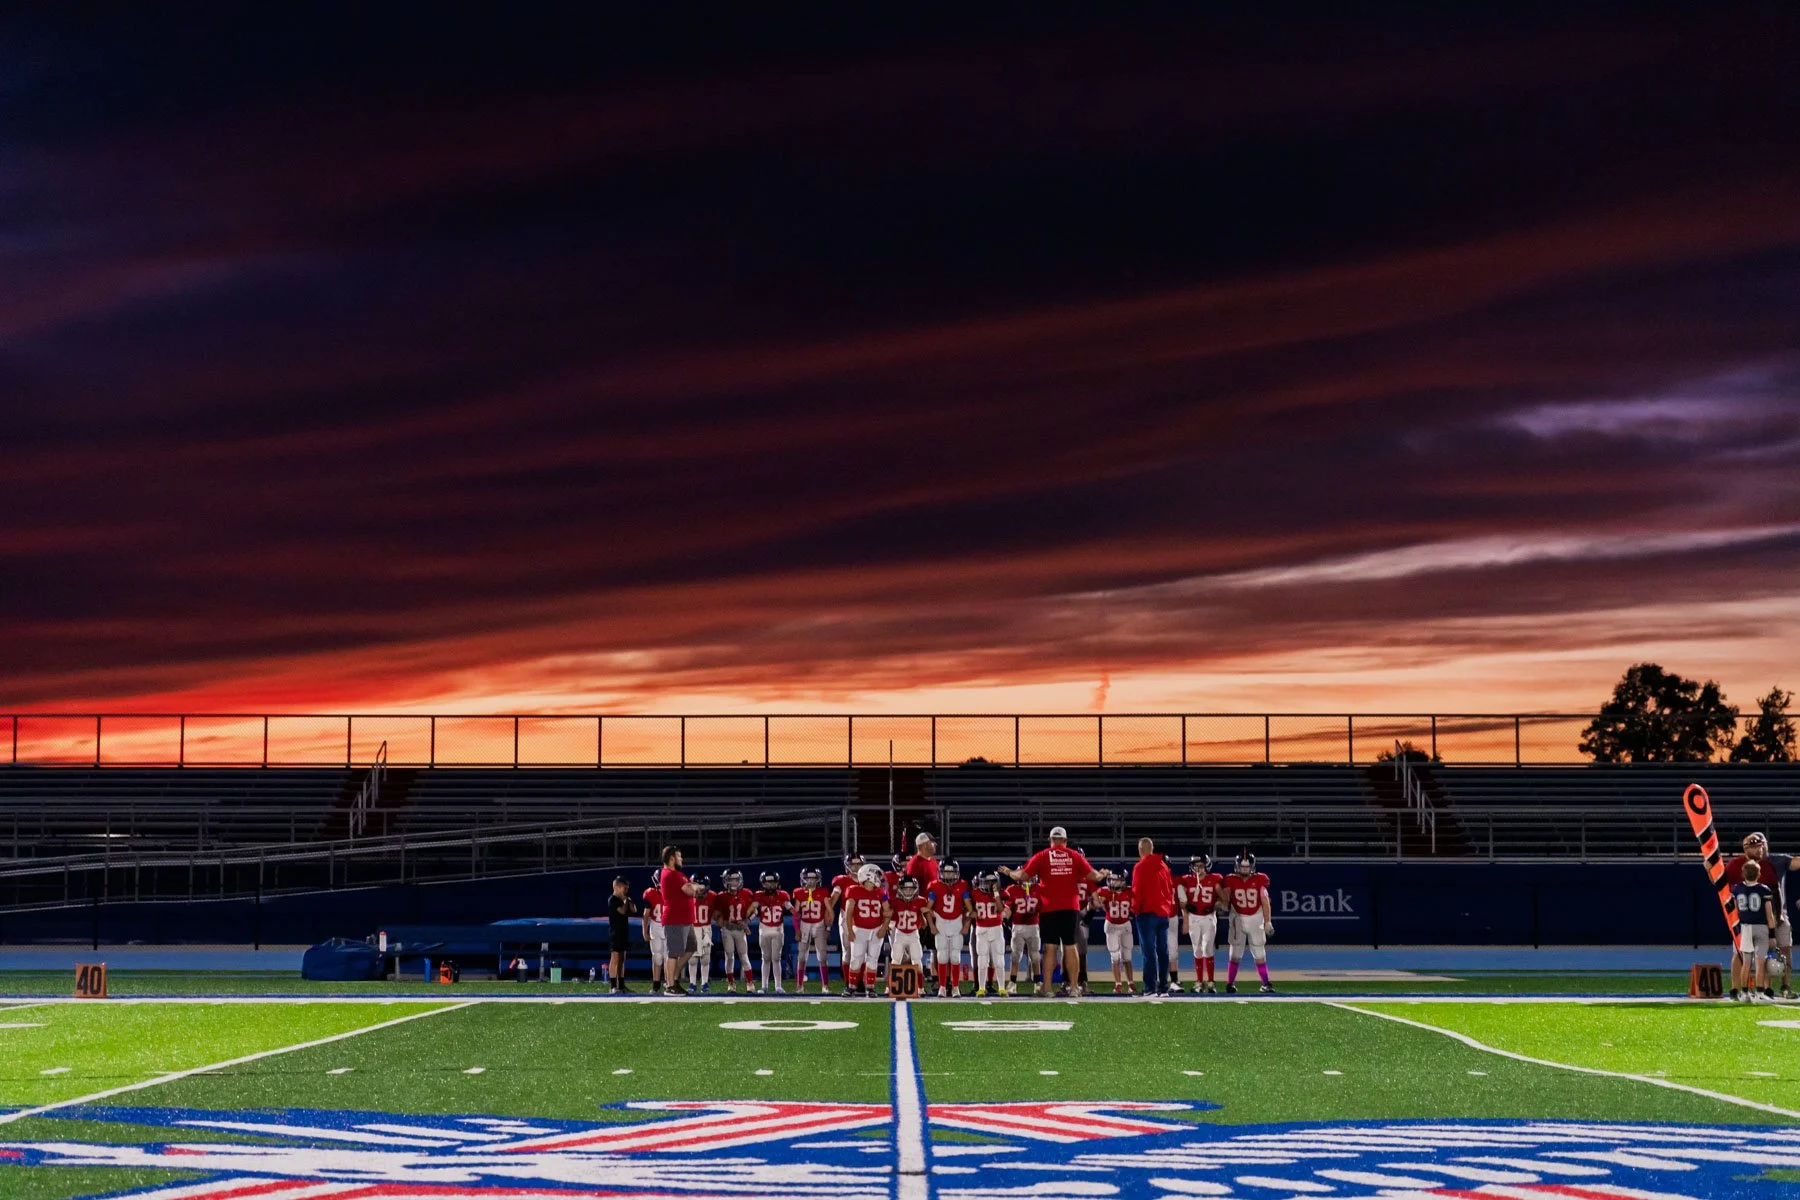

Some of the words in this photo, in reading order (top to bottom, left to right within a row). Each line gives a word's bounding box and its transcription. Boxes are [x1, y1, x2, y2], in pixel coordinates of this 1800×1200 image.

[1077, 883, 1087, 900] 5
[1189, 887, 1213, 903] 75
[1234, 888, 1258, 908] 99
[1280, 888, 1354, 912] Bank
[800, 900, 821, 919] 29
[858, 899, 881, 918] 53
[942, 894, 955, 913] 9
[976, 902, 998, 918] 80
[1109, 901, 1130, 918] 88
[1736, 893, 1762, 912] 20
[729, 903, 742, 922] 11
[760, 905, 783, 923] 36
[77, 966, 102, 995] 40
[891, 968, 916, 995] 50
[1699, 967, 1722, 996] 40
